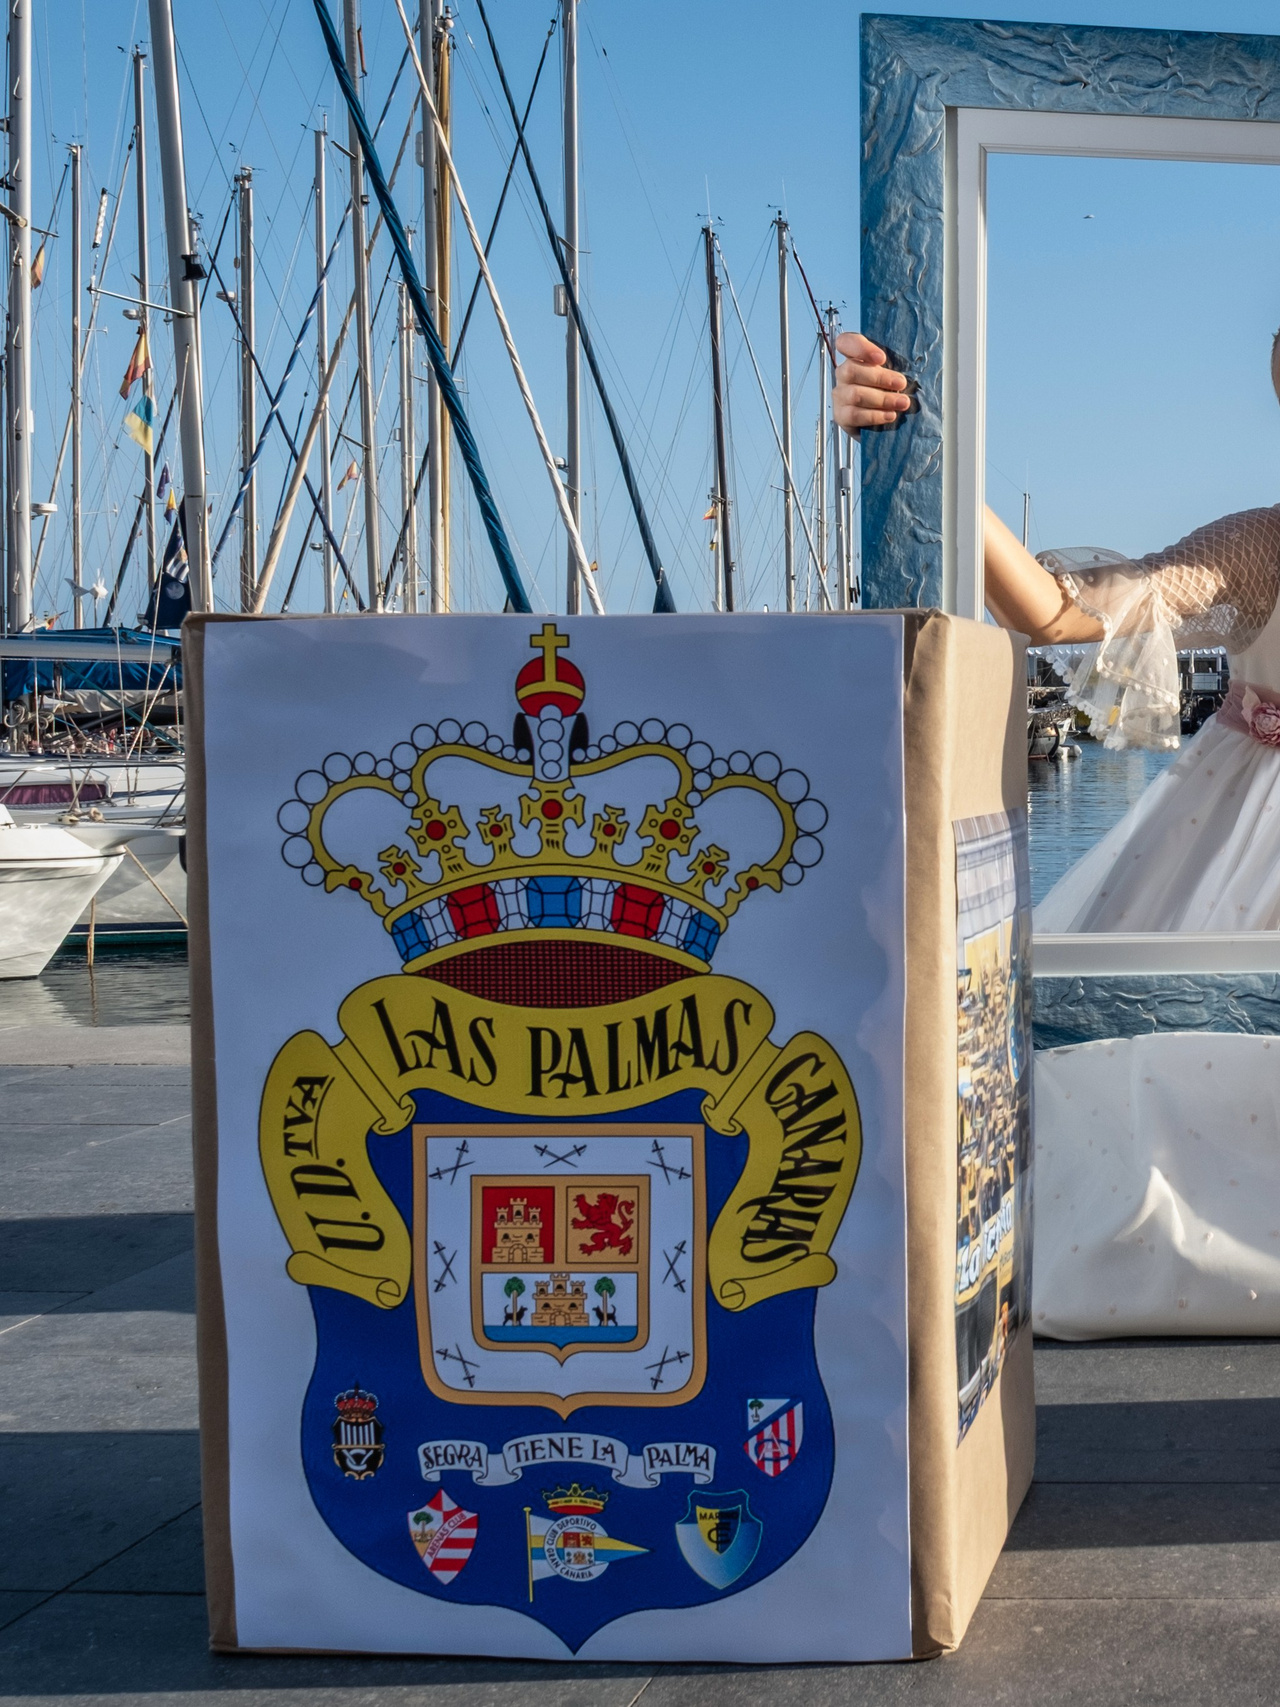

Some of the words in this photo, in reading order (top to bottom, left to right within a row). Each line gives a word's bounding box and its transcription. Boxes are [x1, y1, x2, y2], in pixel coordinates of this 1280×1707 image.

[369, 996, 497, 1087] LAS
[524, 993, 753, 1098] PALMAS
[737, 1053, 847, 1264] CANARIAS
[591, 1439, 618, 1464] LA
[646, 1443, 710, 1471] PALMA
[426, 1527, 450, 1559] ARENAS
[447, 1511, 468, 1529] CLUB
[546, 1529, 559, 1546] CLUB
[557, 1516, 598, 1532] DEPORTIVO
[545, 1548, 561, 1569] GRAN
[559, 1566, 594, 1580] CANARIA
